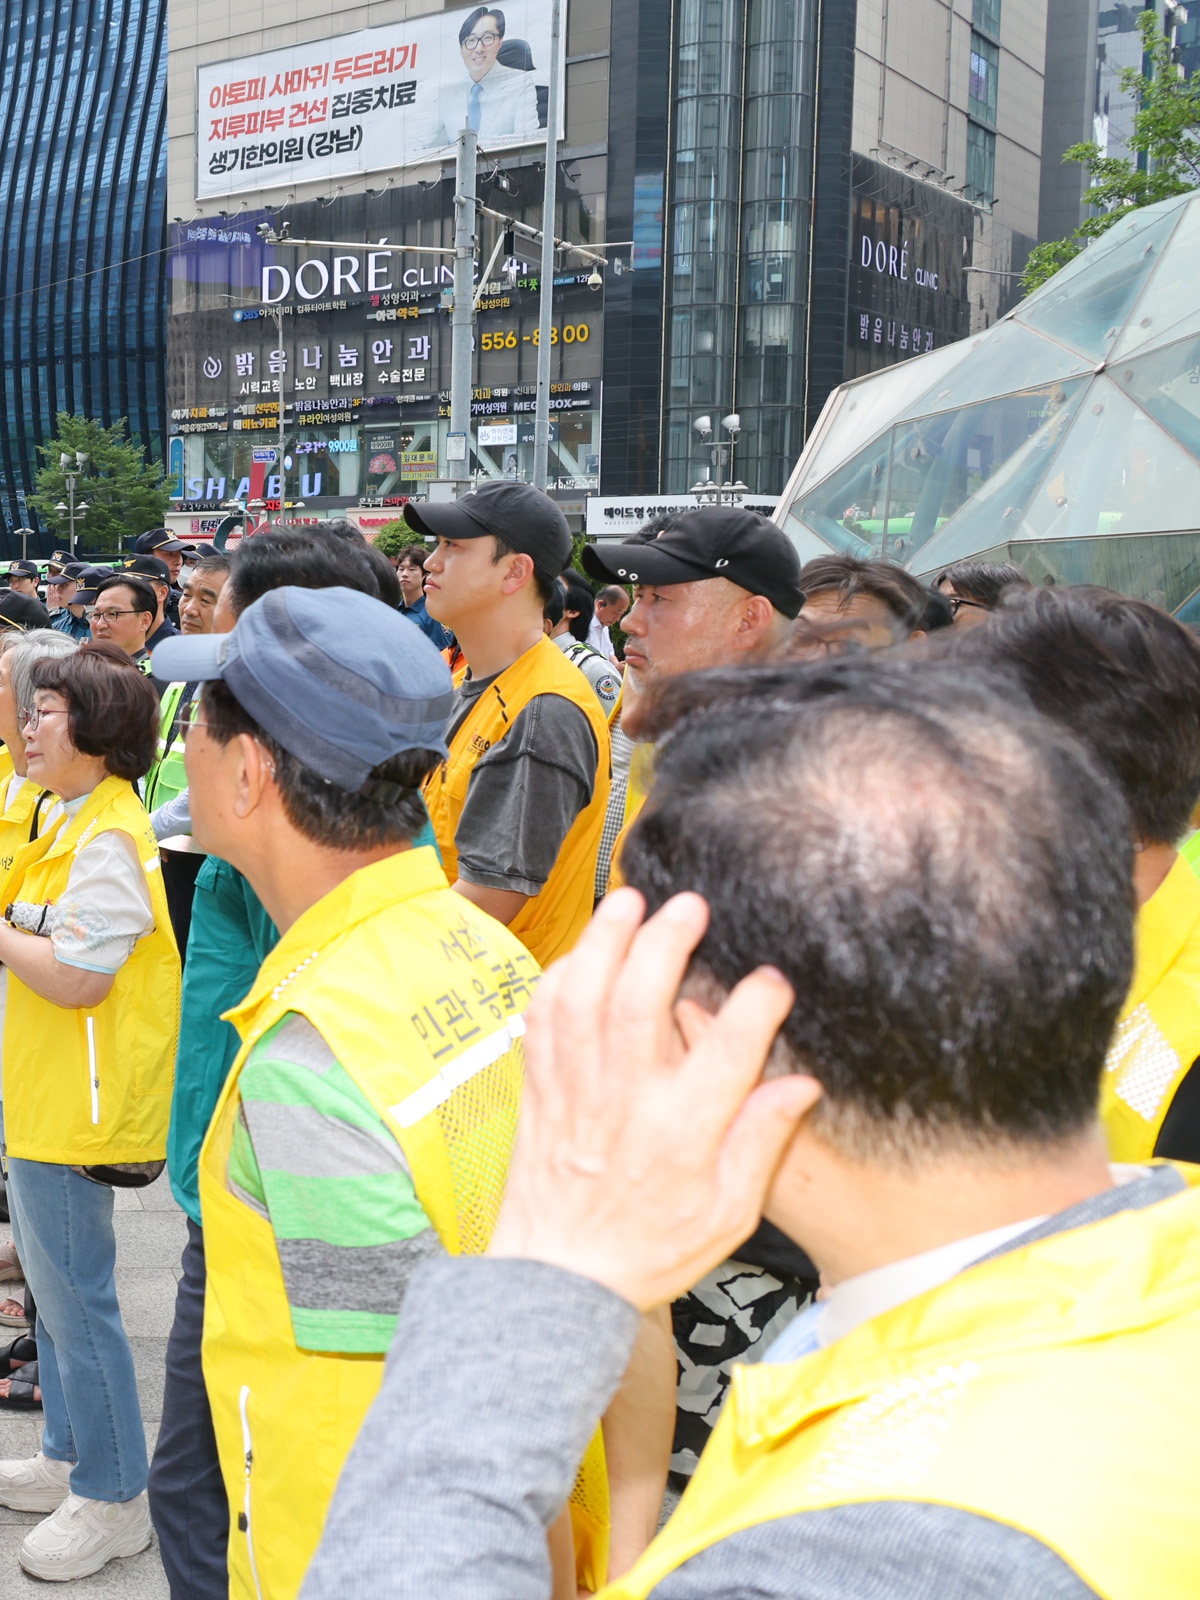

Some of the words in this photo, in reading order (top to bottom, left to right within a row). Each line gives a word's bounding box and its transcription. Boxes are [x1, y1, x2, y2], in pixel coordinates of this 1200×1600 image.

[208, 80, 266, 109] 아토피
[270, 63, 329, 96] 사마귀
[332, 43, 417, 83] 두드러기
[208, 108, 285, 142] 지루피부
[288, 96, 329, 129] 건선
[331, 80, 417, 119] 집중치료
[208, 136, 305, 175] 생기한의원
[307, 125, 364, 160] (강남)
[262, 238, 393, 303] DORÉ
[403, 262, 479, 287] CLIN
[862, 235, 909, 280] DORÉ
[915, 268, 938, 290] CLINIC
[297, 300, 347, 314] 컴퓨터아트학원
[240, 379, 281, 395] 시력교정
[294, 376, 317, 391] 노안
[329, 372, 364, 388] 백내장
[377, 367, 426, 384] 수술전문
[295, 398, 348, 411] 밝음나눔안과
[514, 398, 572, 411] MEGBOX
[186, 472, 322, 500] SHABU
